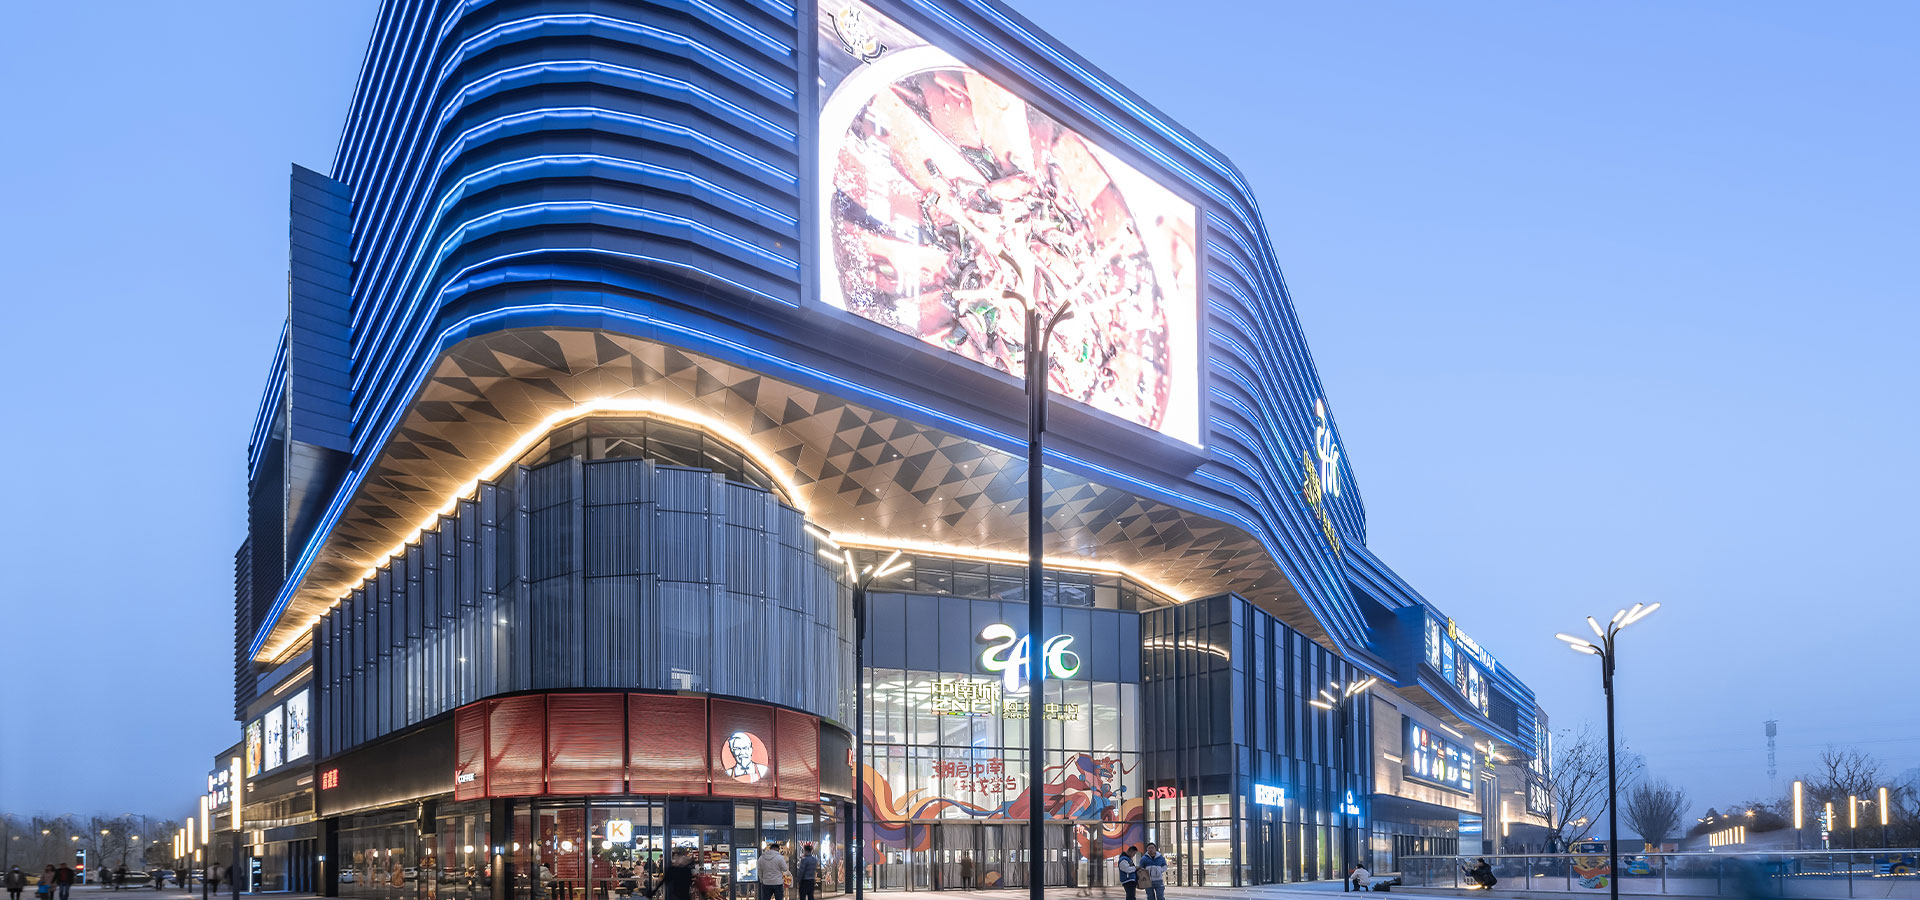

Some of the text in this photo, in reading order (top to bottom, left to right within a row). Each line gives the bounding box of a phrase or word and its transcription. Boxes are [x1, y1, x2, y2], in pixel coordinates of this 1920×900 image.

[931, 679, 1000, 703] 中南城
[611, 822, 625, 837] K
